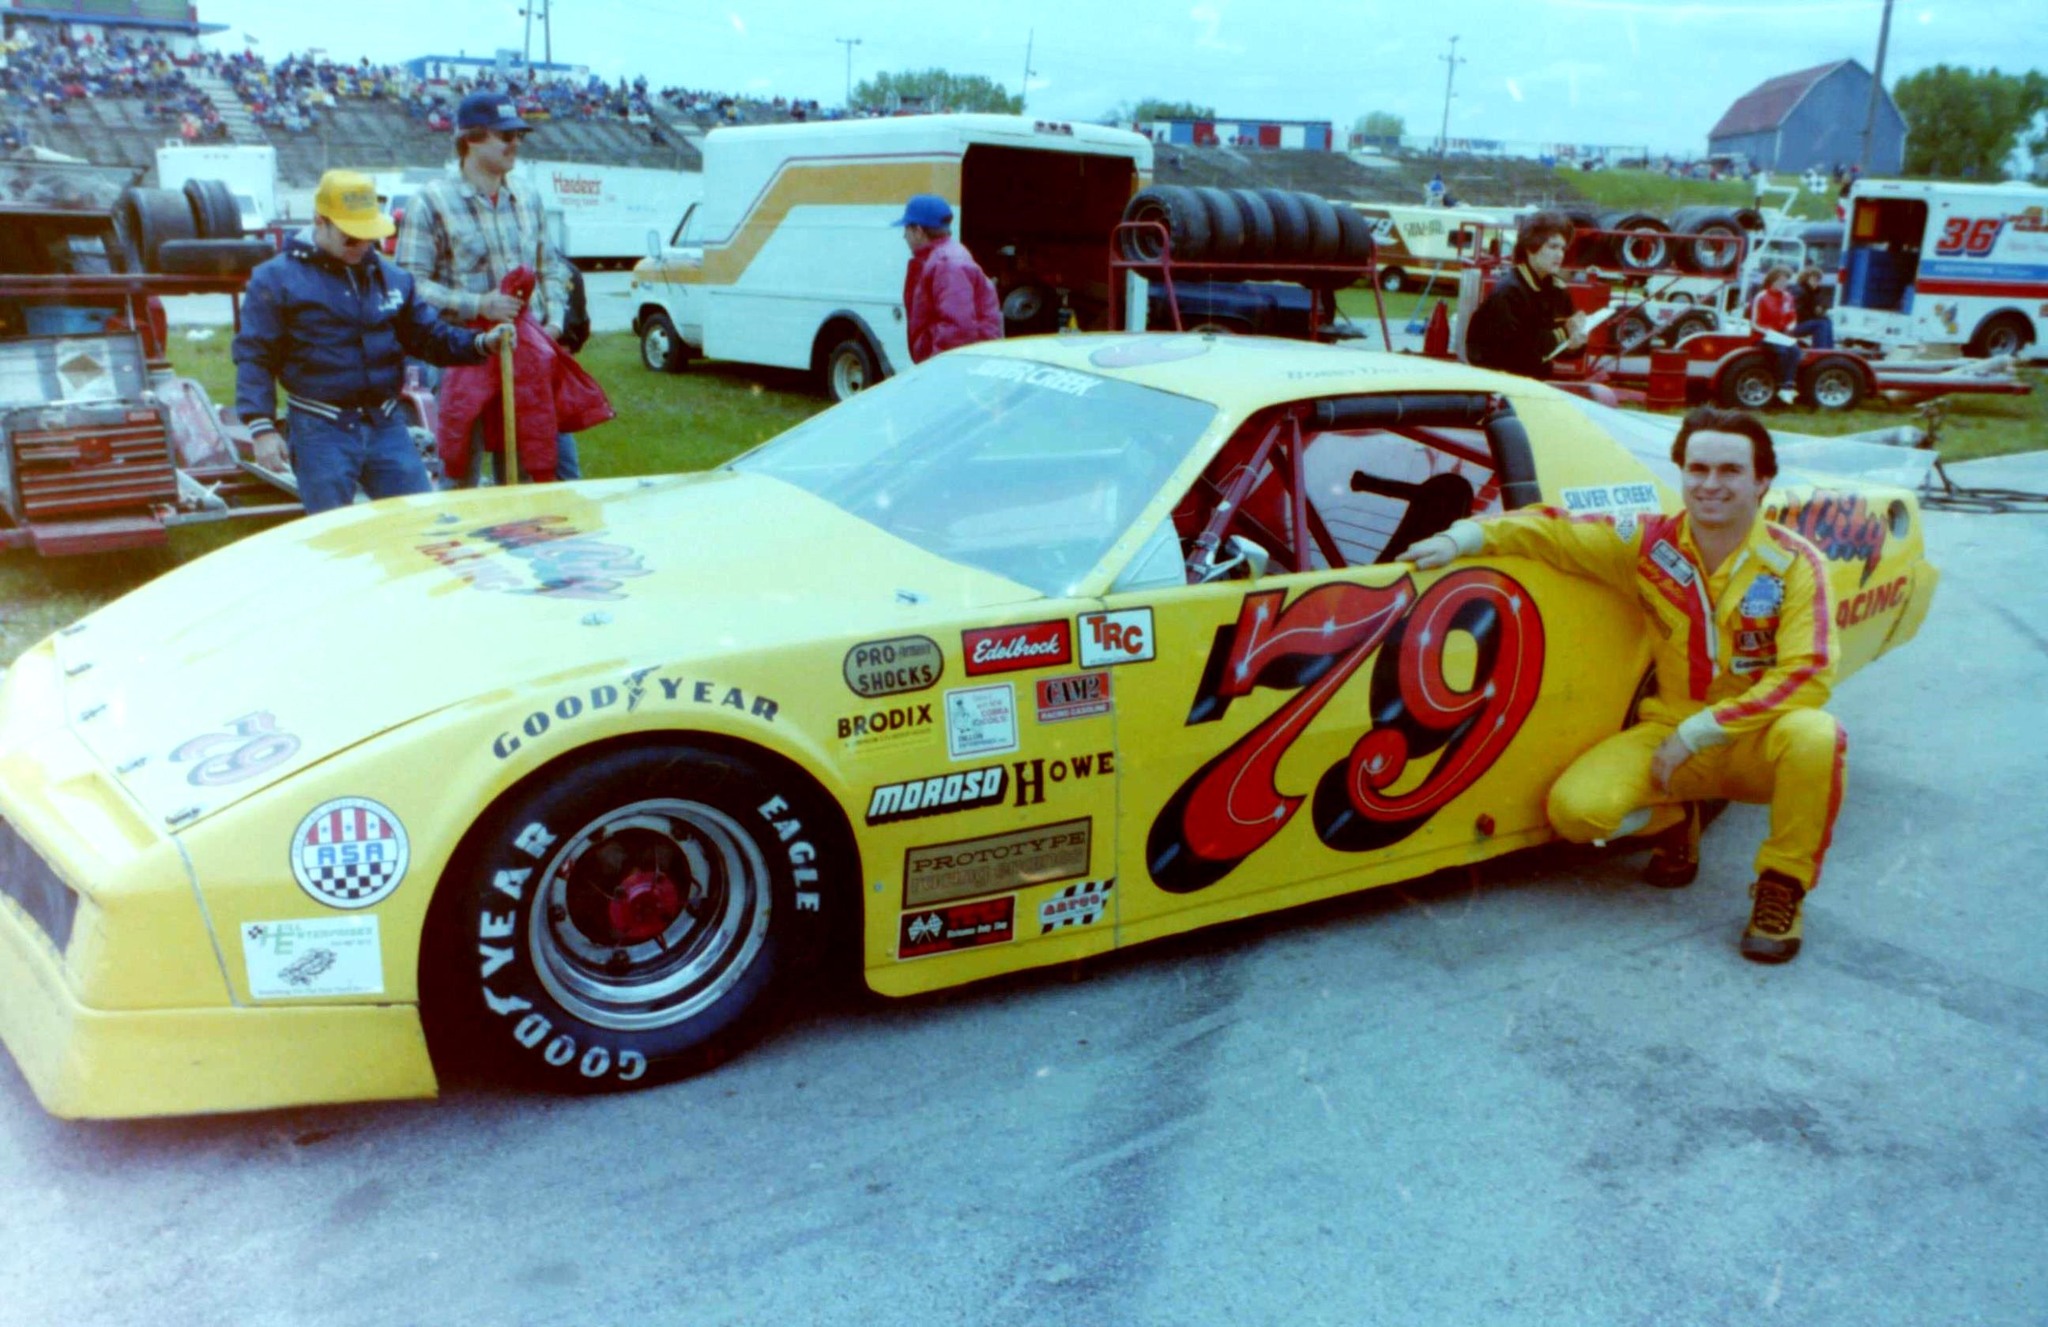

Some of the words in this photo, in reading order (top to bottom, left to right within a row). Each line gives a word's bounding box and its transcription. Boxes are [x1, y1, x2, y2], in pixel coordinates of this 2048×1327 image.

[1936, 217, 2005, 258] 36
[1564, 489, 1611, 510] SILVER
[1613, 485, 1658, 505] CREEK
[1835, 576, 1907, 629] ACING
[972, 633, 1061, 664] Edelbrock
[1087, 616, 1143, 655] TRC
[858, 664, 934, 692] SHOCKS
[1046, 676, 1100, 705] CAM2
[837, 703, 933, 739] BRODIX
[1146, 566, 1546, 893] 79
[168, 711, 302, 786] 79
[866, 766, 1006, 819] MOROSO
[1012, 752, 1115, 808] HOWE
[317, 842, 384, 865] ASA
[757, 794, 820, 912] EAGLE
[912, 831, 1087, 873] PROTOTYPE
[479, 821, 648, 1081] GOODYEAR
